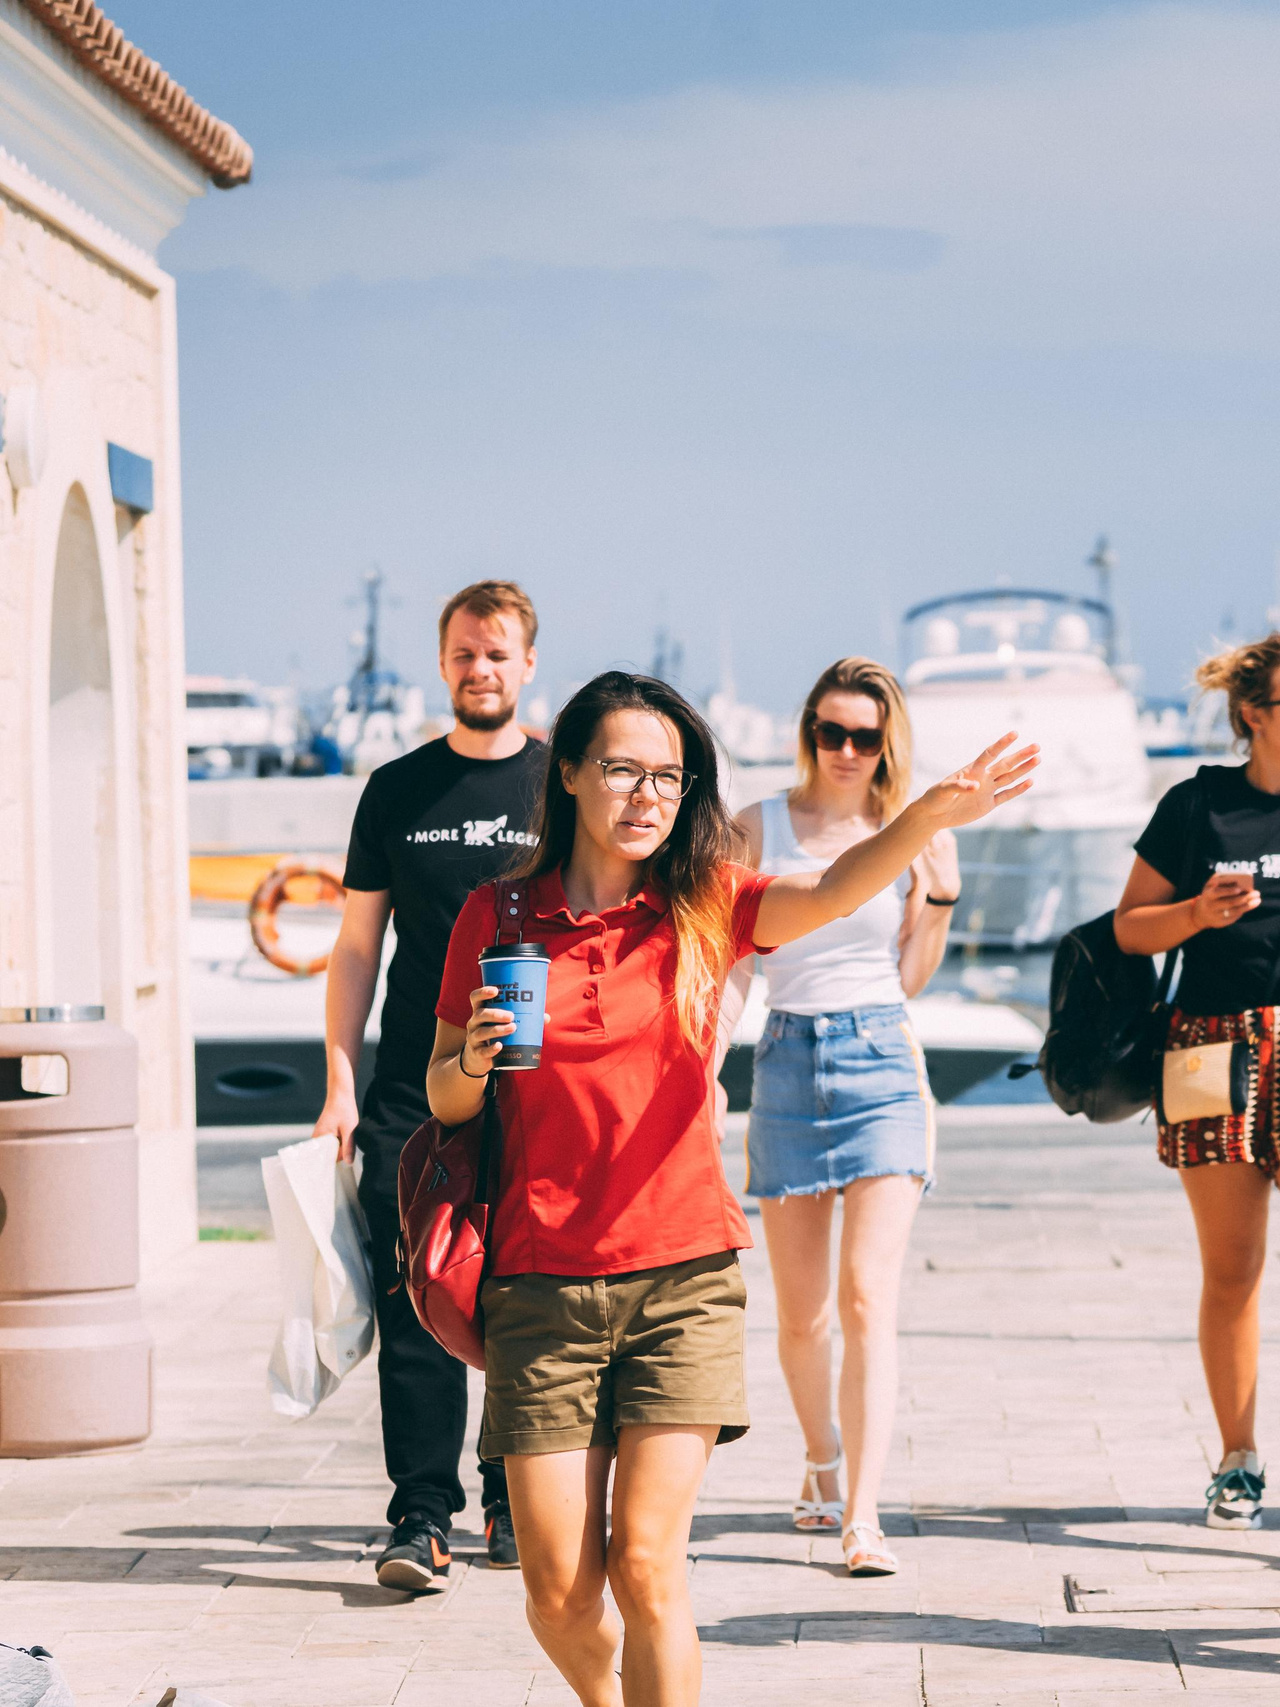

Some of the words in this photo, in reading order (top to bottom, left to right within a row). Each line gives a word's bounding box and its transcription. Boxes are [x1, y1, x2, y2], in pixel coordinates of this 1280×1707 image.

[414, 829, 459, 843] MORE
[1215, 861, 1258, 874] MORE
[488, 990, 533, 1003] ERO
